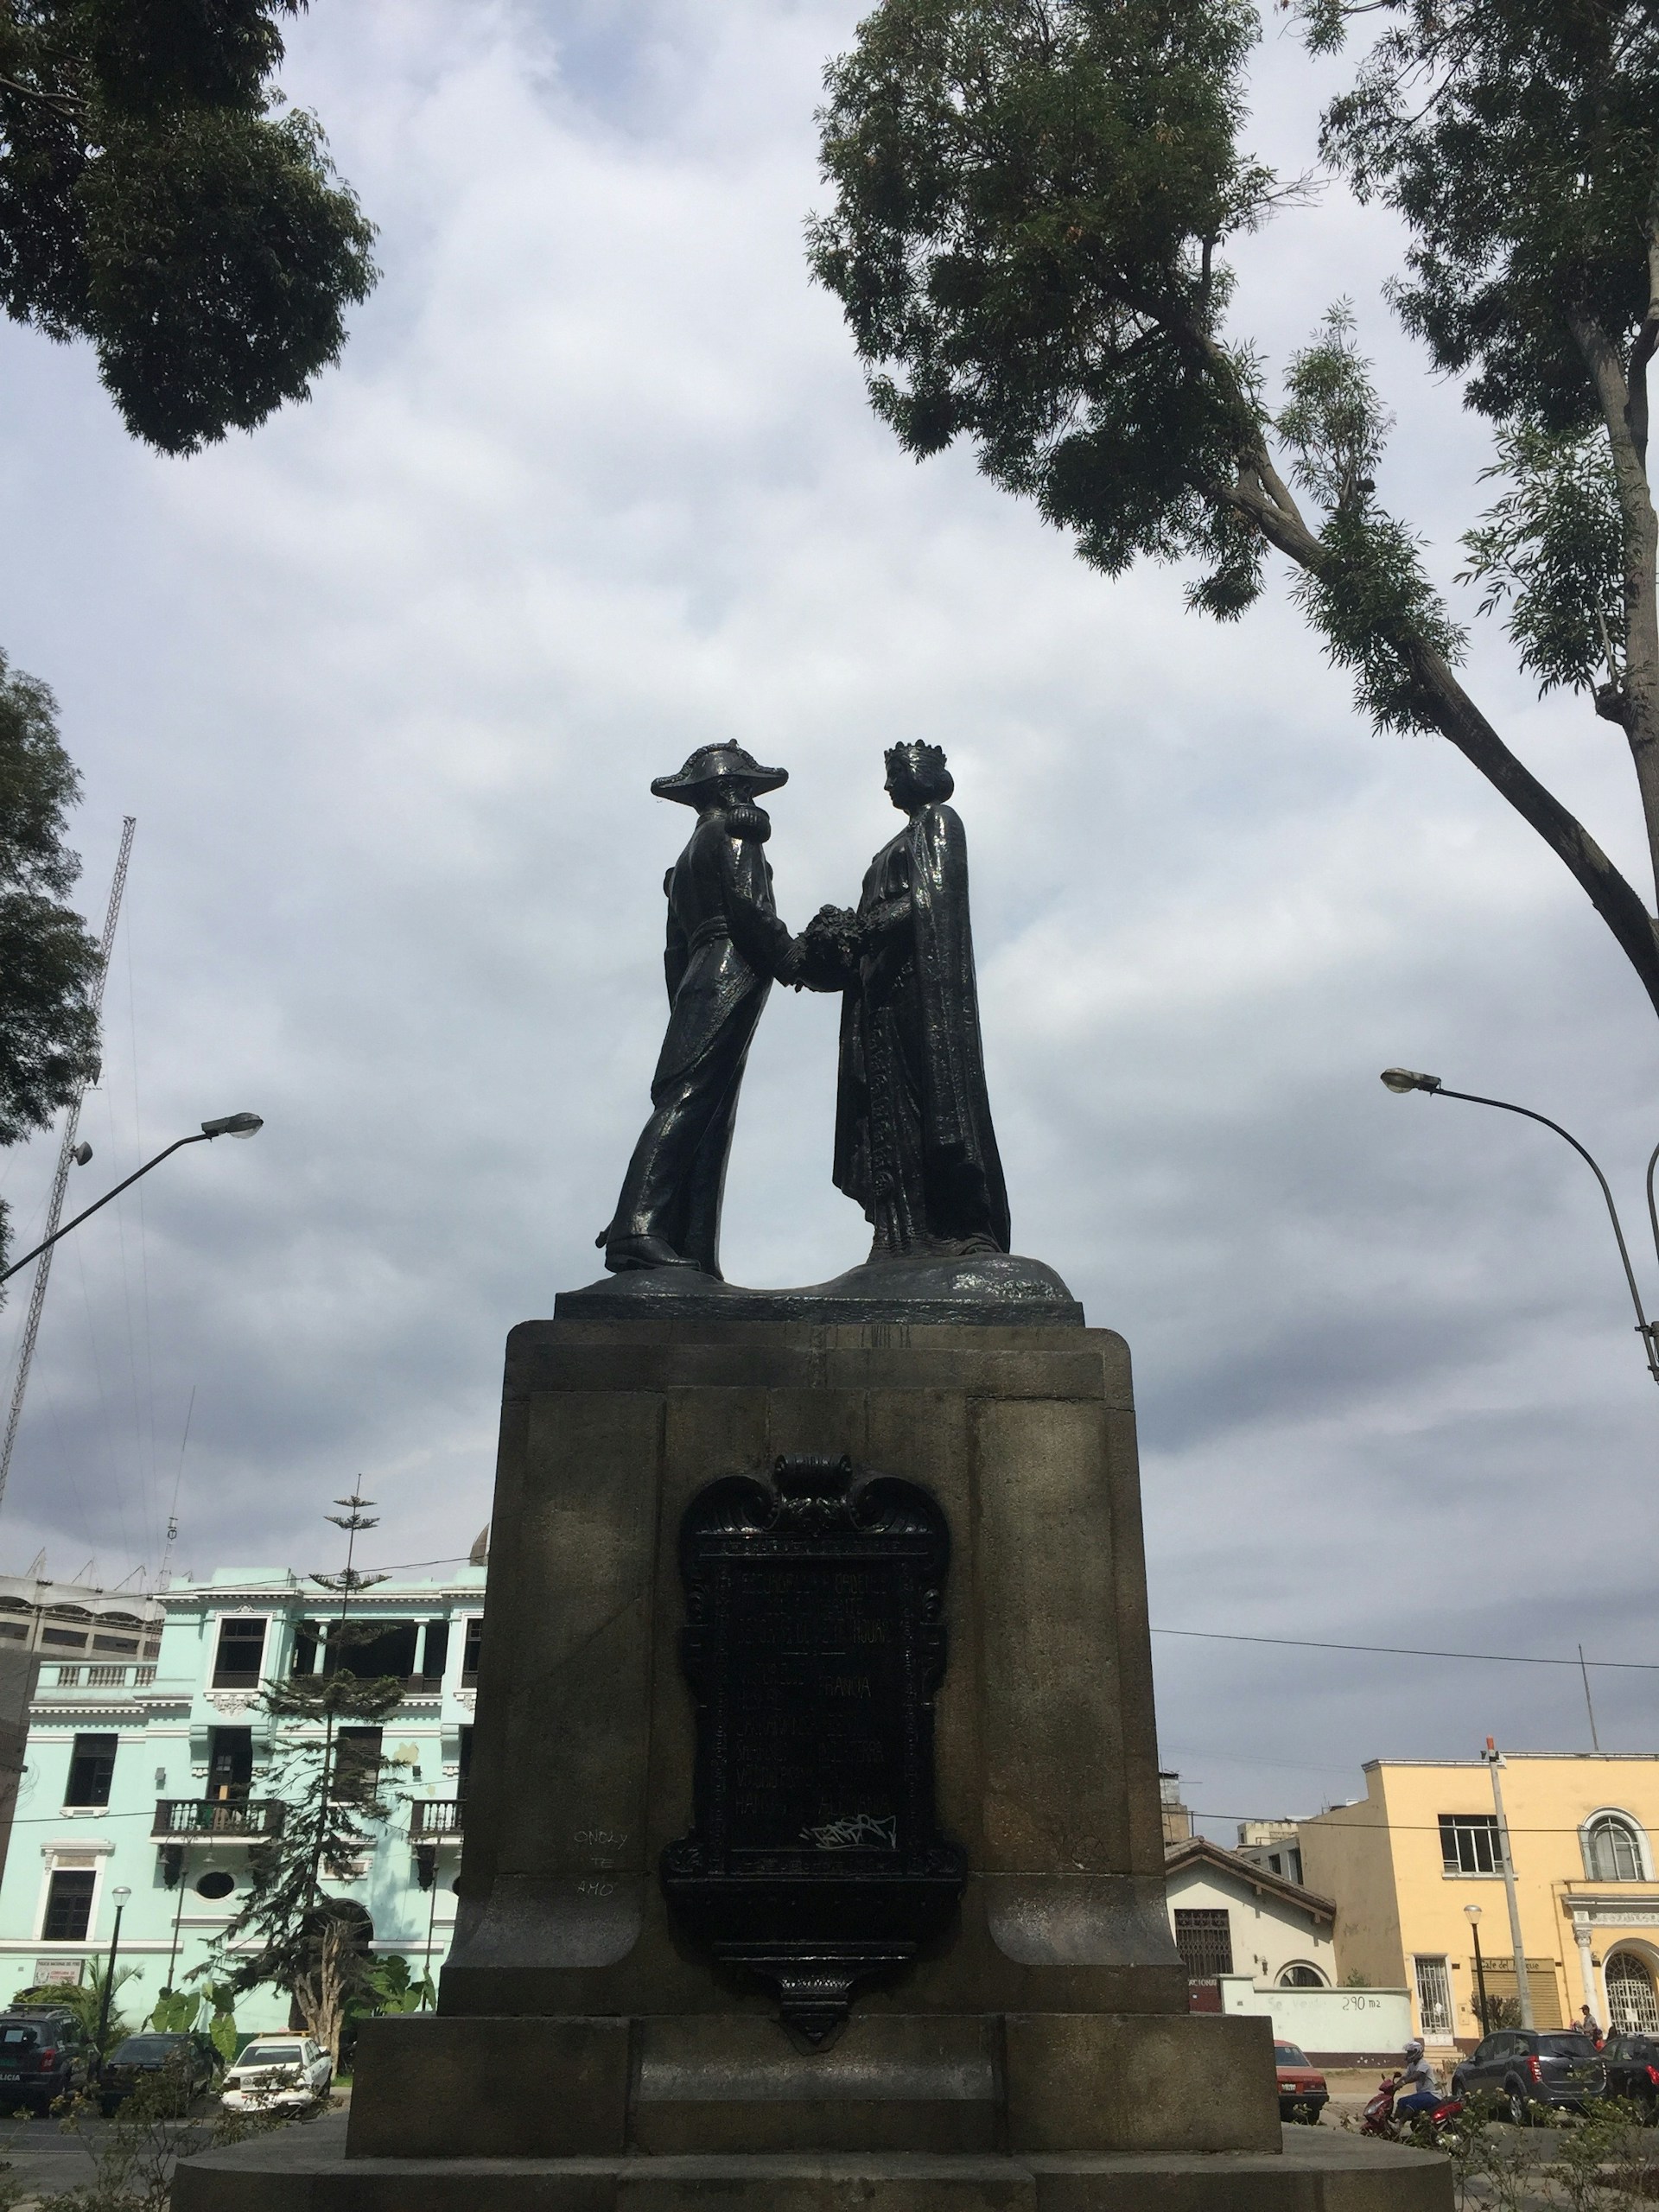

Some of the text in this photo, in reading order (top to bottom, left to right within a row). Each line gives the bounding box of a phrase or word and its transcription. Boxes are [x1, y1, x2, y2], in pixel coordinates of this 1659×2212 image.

[590, 1858, 615, 1869] TE
[577, 1880, 613, 1897] AMO
[1342, 1996, 1365, 2011] 290
[1368, 1999, 1382, 2008] m2
